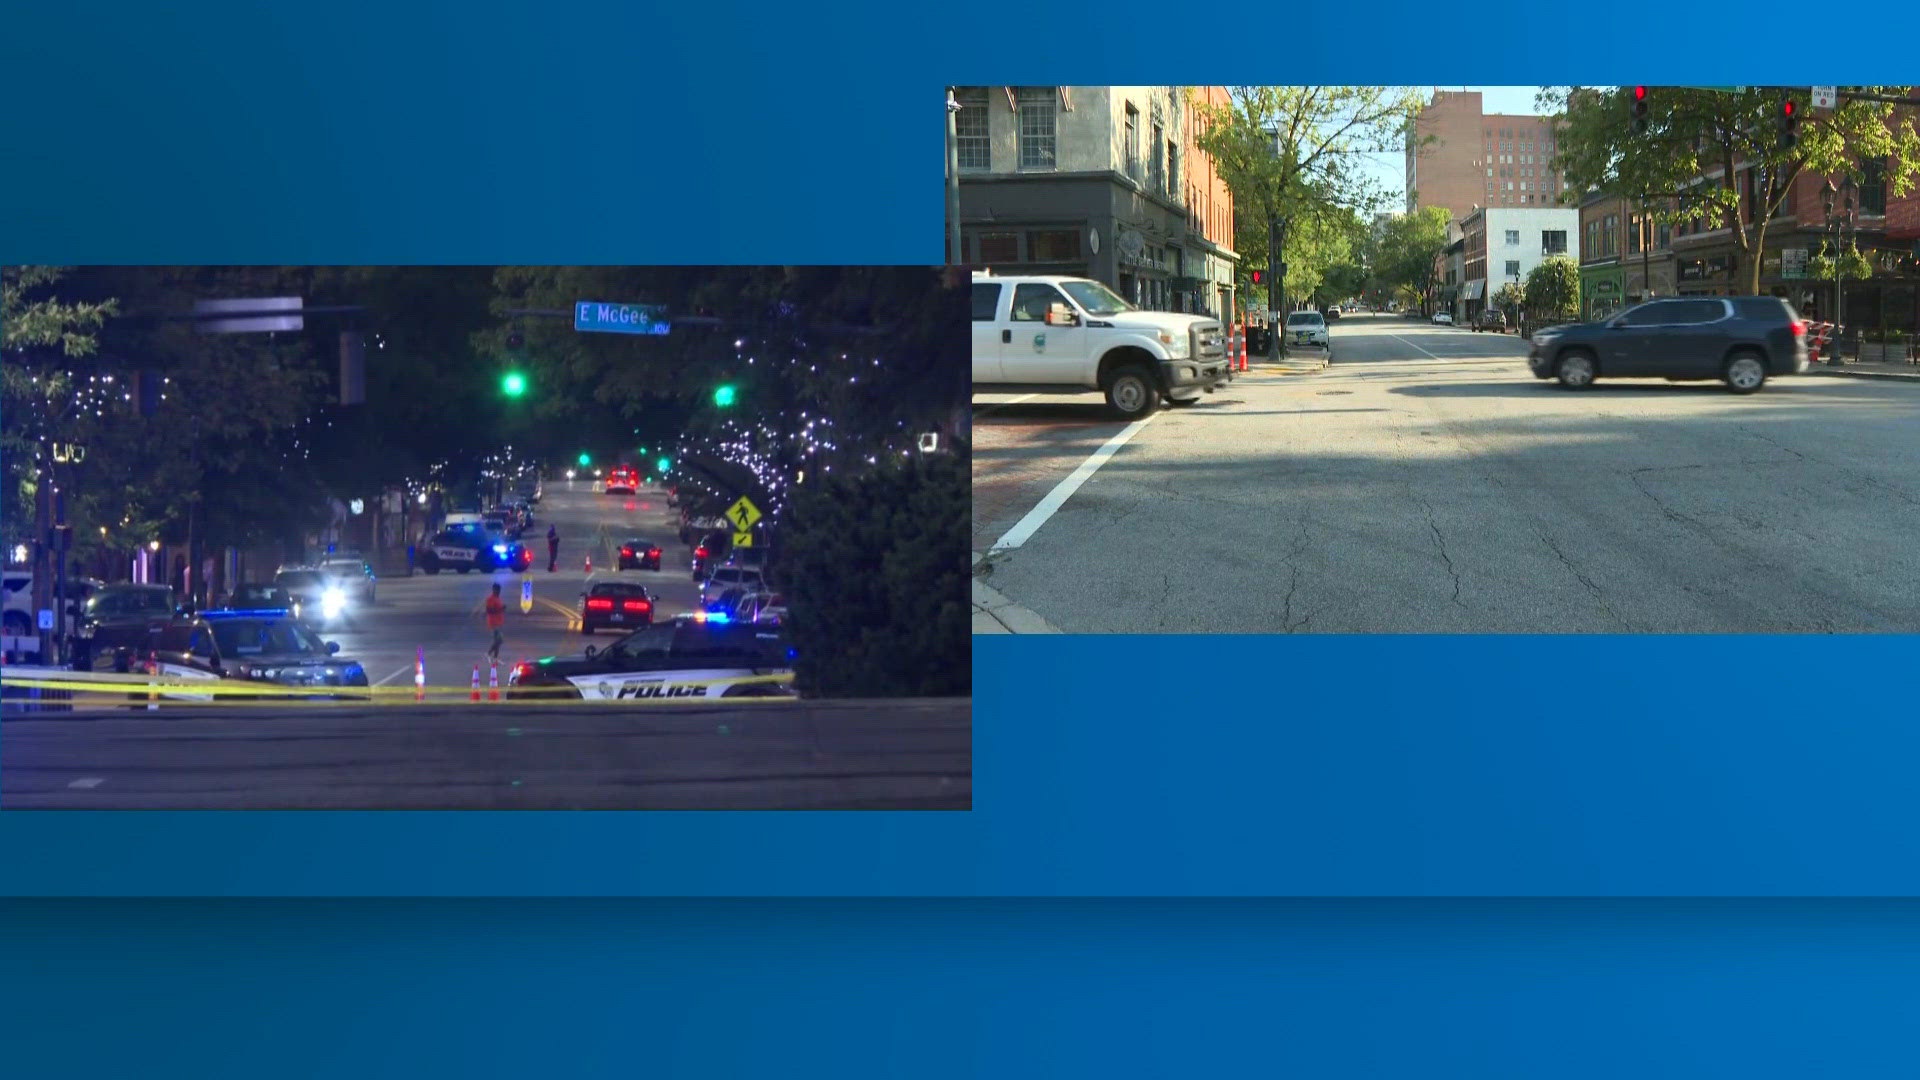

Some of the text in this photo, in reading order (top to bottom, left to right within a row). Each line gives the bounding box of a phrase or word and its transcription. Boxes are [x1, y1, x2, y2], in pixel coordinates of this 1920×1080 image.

[581, 304, 590, 321] E
[598, 304, 648, 324] McGee
[617, 685, 708, 700] POLICE
